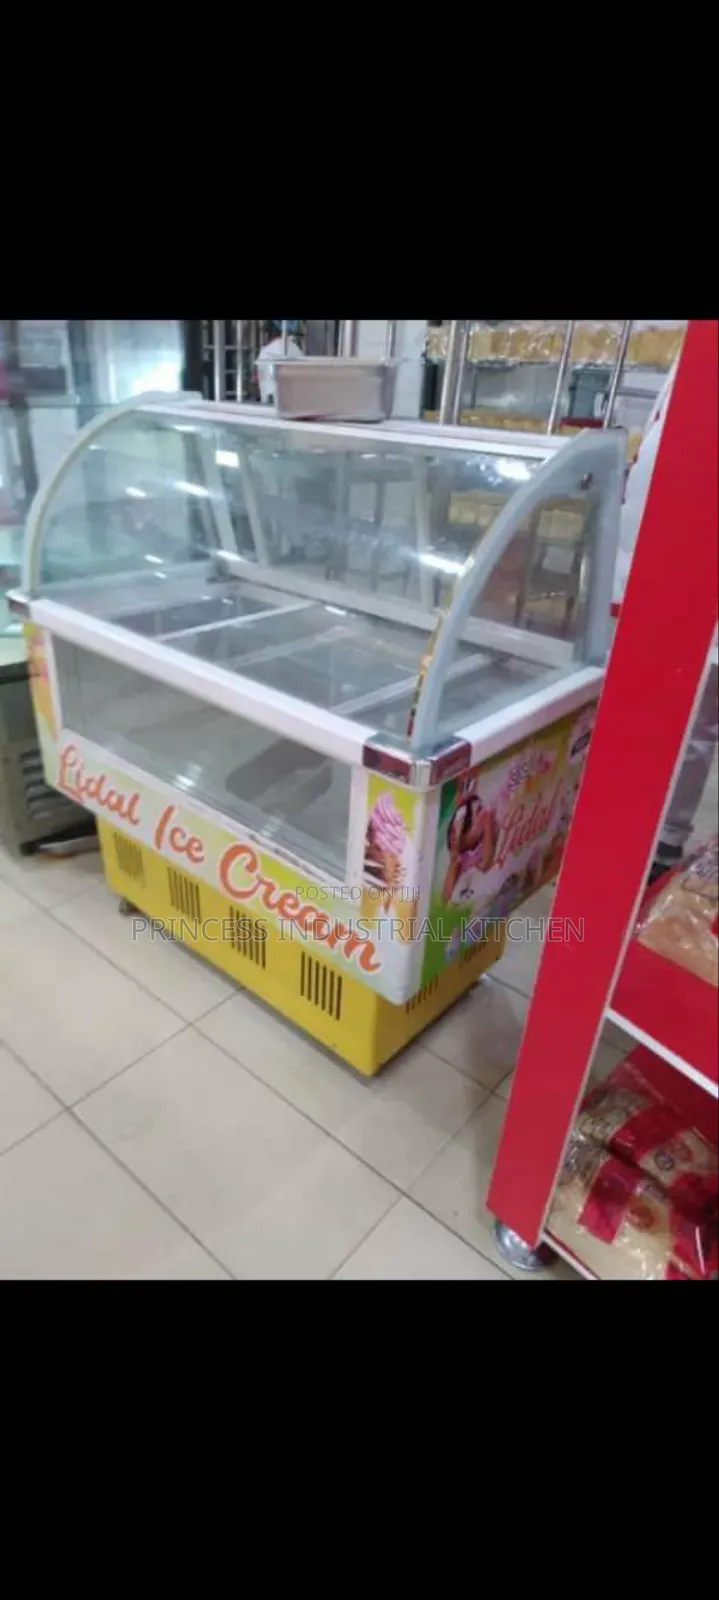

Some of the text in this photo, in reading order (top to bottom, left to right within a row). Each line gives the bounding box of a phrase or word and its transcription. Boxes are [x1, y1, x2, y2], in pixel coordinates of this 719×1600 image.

[59, 745, 381, 972] Lidal Ice Cream
